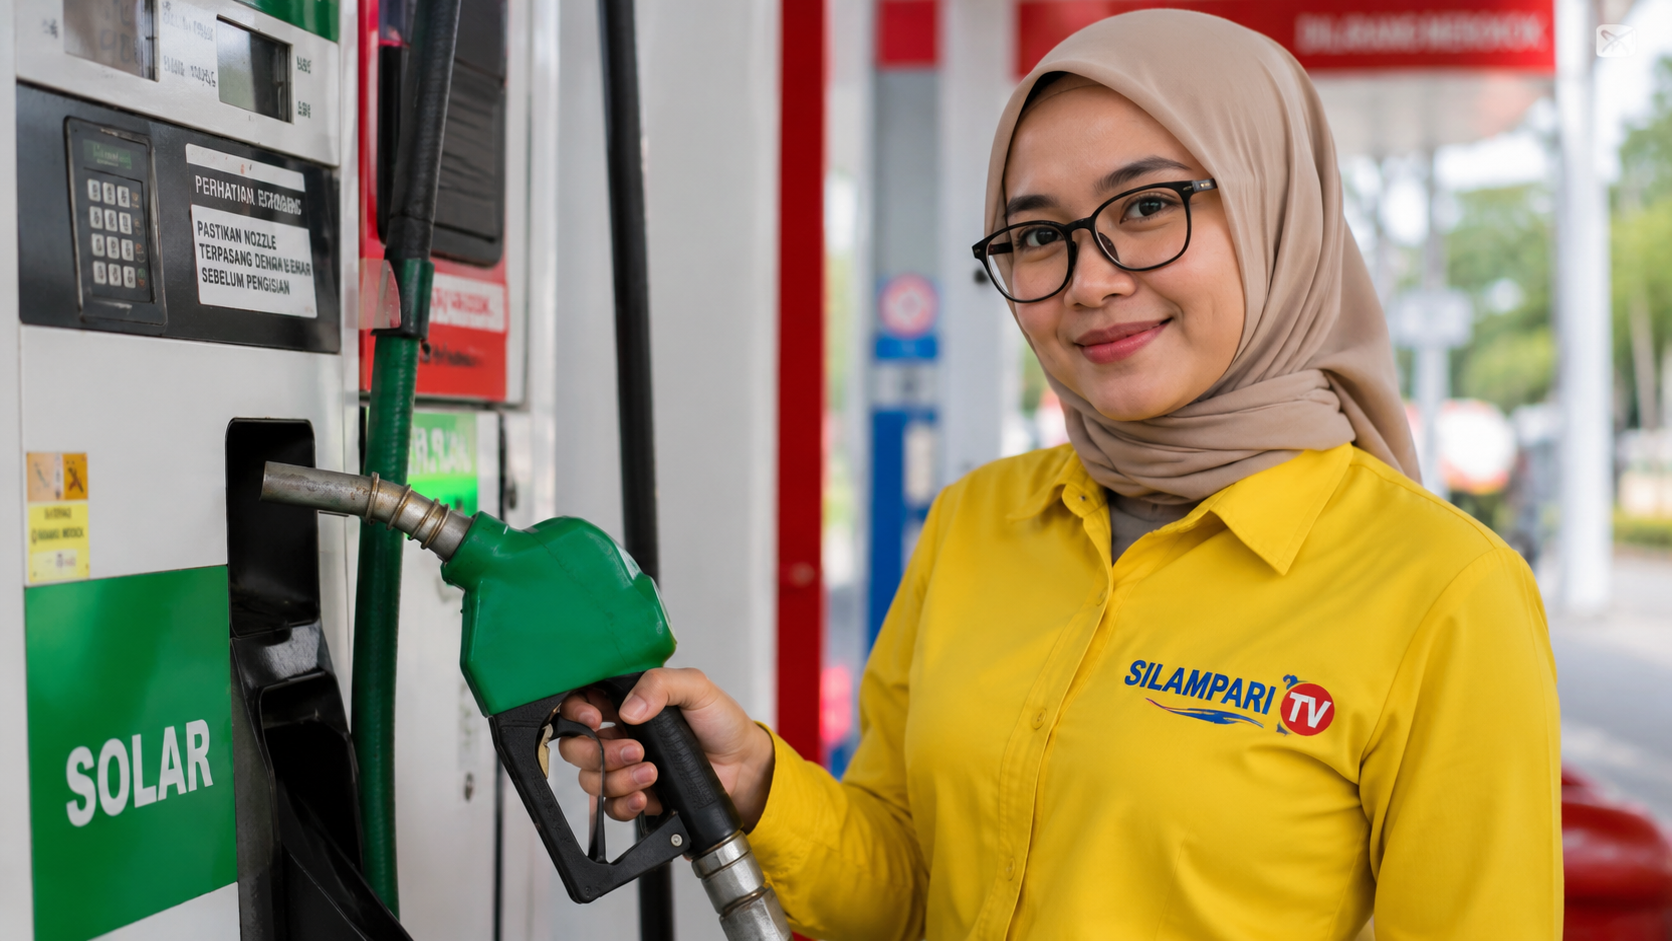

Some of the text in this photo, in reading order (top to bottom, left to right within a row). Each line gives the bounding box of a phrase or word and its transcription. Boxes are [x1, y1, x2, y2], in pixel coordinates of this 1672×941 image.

[197, 220, 277, 250] PASTIKAN NOZZLE
[199, 243, 252, 267] TERPASANG
[202, 267, 290, 295] SEBELUM PENGISIAN
[1124, 660, 1332, 729] SILAMPARI TV
[66, 719, 213, 827] SOLAR
